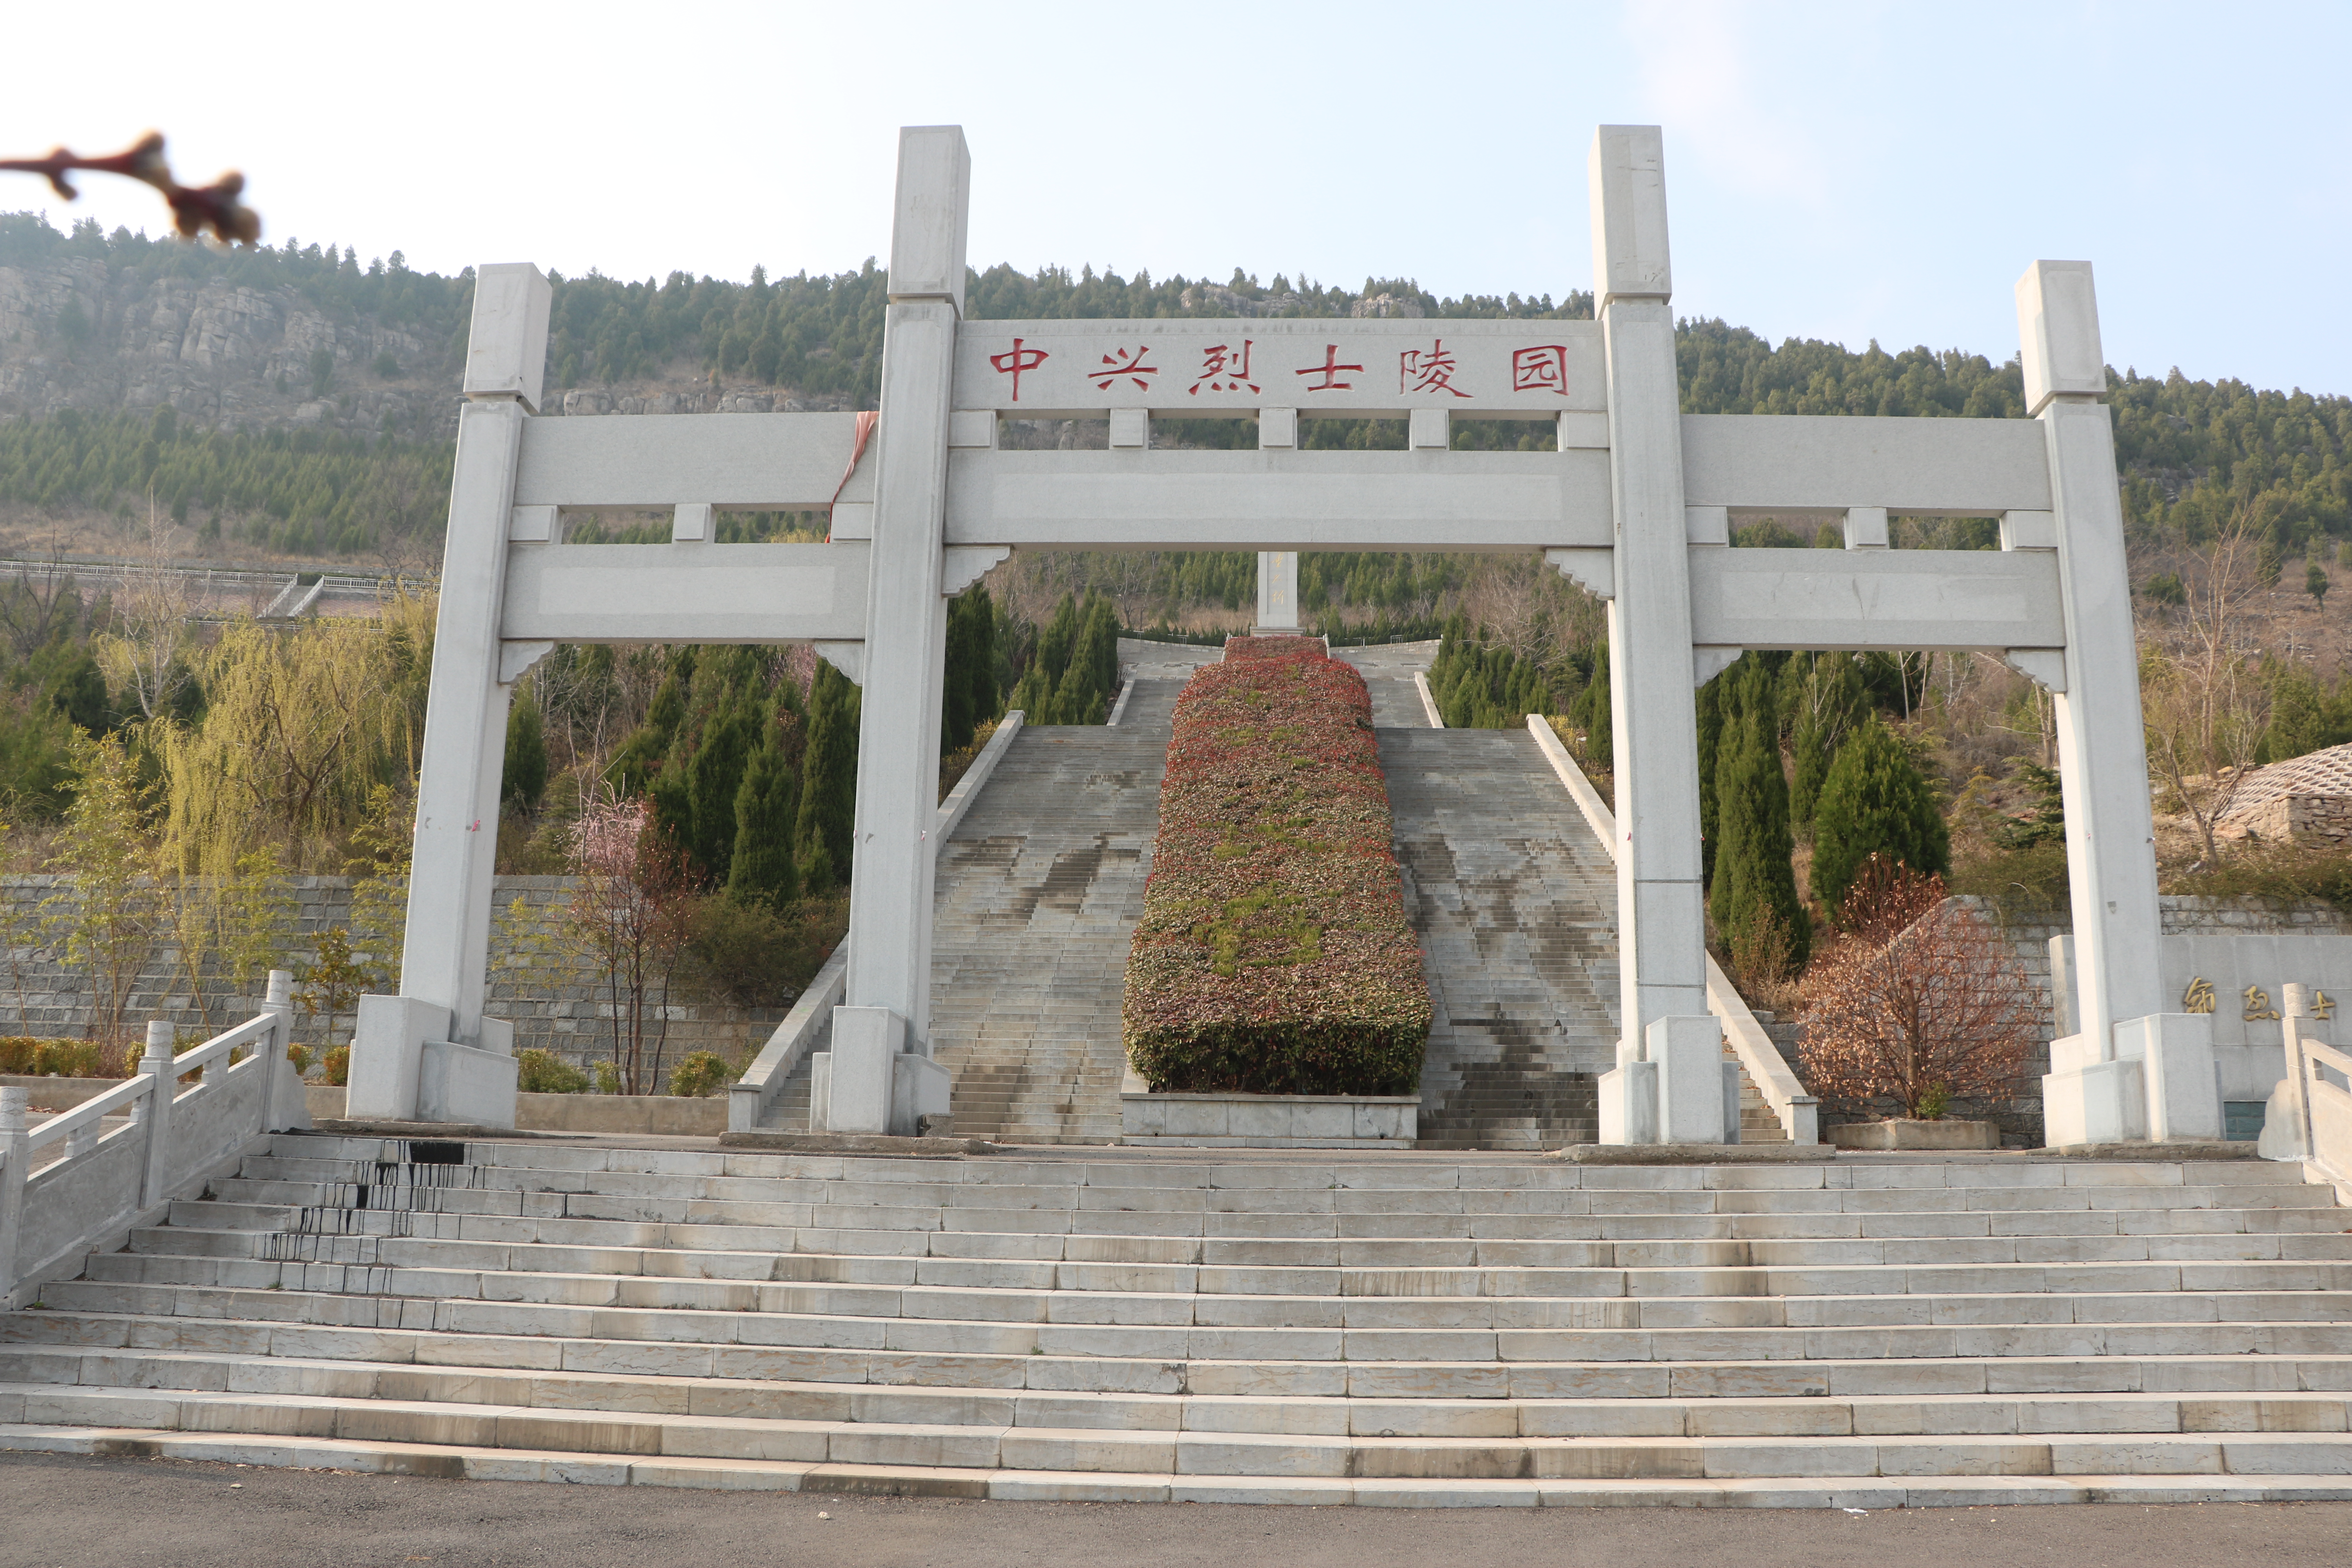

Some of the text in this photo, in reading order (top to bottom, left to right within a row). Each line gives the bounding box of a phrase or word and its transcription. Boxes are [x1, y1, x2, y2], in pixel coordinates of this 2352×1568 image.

[989, 338, 1569, 402] 中兴烈士陵园
